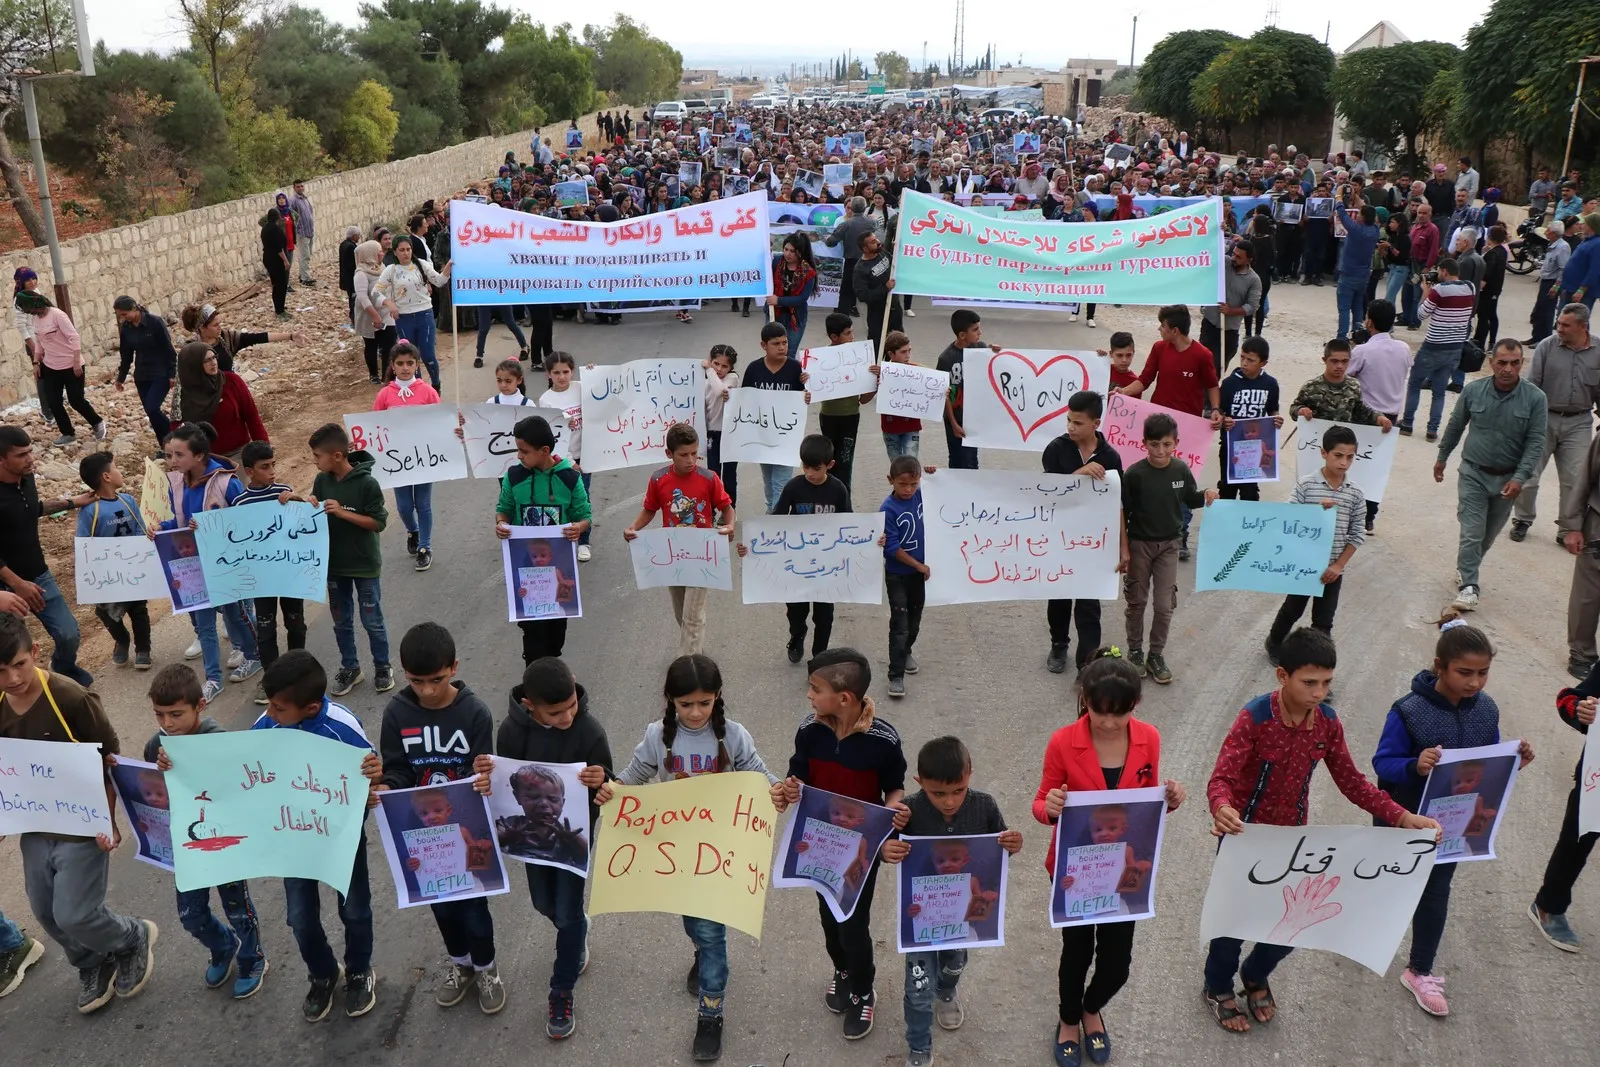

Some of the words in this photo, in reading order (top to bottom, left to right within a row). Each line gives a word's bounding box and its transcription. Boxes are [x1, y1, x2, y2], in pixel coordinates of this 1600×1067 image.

[457, 220, 524, 247] السوري
[530, 222, 590, 246] للشعب
[720, 208, 757, 237] كفى
[910, 209, 972, 236] التركي
[1066, 229, 1122, 254] شركاء
[510, 253, 569, 266] хватит
[696, 250, 707, 261] и
[903, 244, 925, 257] не
[930, 243, 992, 264] будьте
[1118, 251, 1211, 274] турецкой
[456, 277, 583, 294] игнорировать
[587, 273, 694, 293] сирийского
[699, 269, 762, 288] народа
[998, 281, 1105, 297] оккупации
[1233, 389, 1269, 404] #RUN
[401, 725, 470, 754] FILA
[613, 796, 714, 836] Rojava
[1248, 835, 1337, 885] قتل
